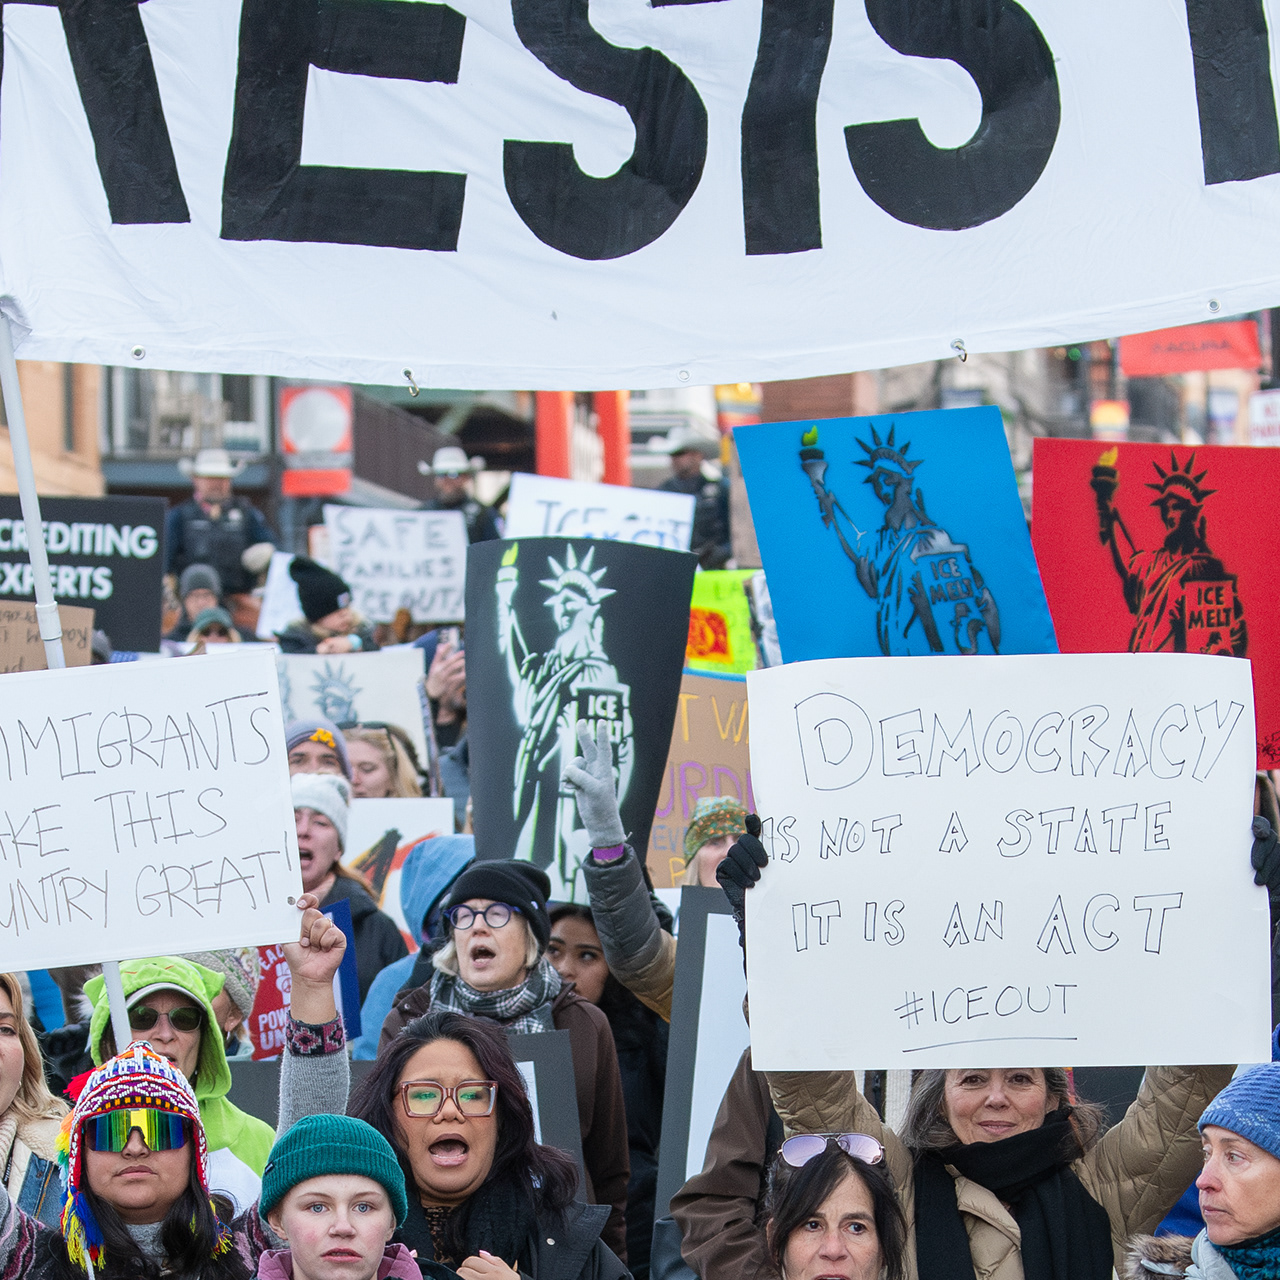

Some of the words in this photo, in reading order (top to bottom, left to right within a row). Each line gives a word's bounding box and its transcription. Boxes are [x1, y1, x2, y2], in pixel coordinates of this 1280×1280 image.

[335, 509, 452, 554] SAFE
[929, 577, 974, 605] MELT
[930, 558, 961, 580] ICE
[1196, 585, 1225, 606] ICE
[1188, 608, 1233, 631] MELT
[587, 694, 619, 720] ICE
[793, 691, 1246, 793] DEMOCRACY
[93, 787, 228, 854] THIS
[761, 815, 801, 864] IS
[819, 814, 904, 860] NOT
[937, 810, 970, 855] A
[996, 800, 1173, 859] STATE
[135, 830, 296, 919] GREAT!
[791, 899, 842, 953] IT
[863, 902, 907, 948] IS
[942, 901, 1005, 949] AN
[1036, 892, 1185, 955] ACT
[894, 983, 1080, 1030] #ICEOUT
